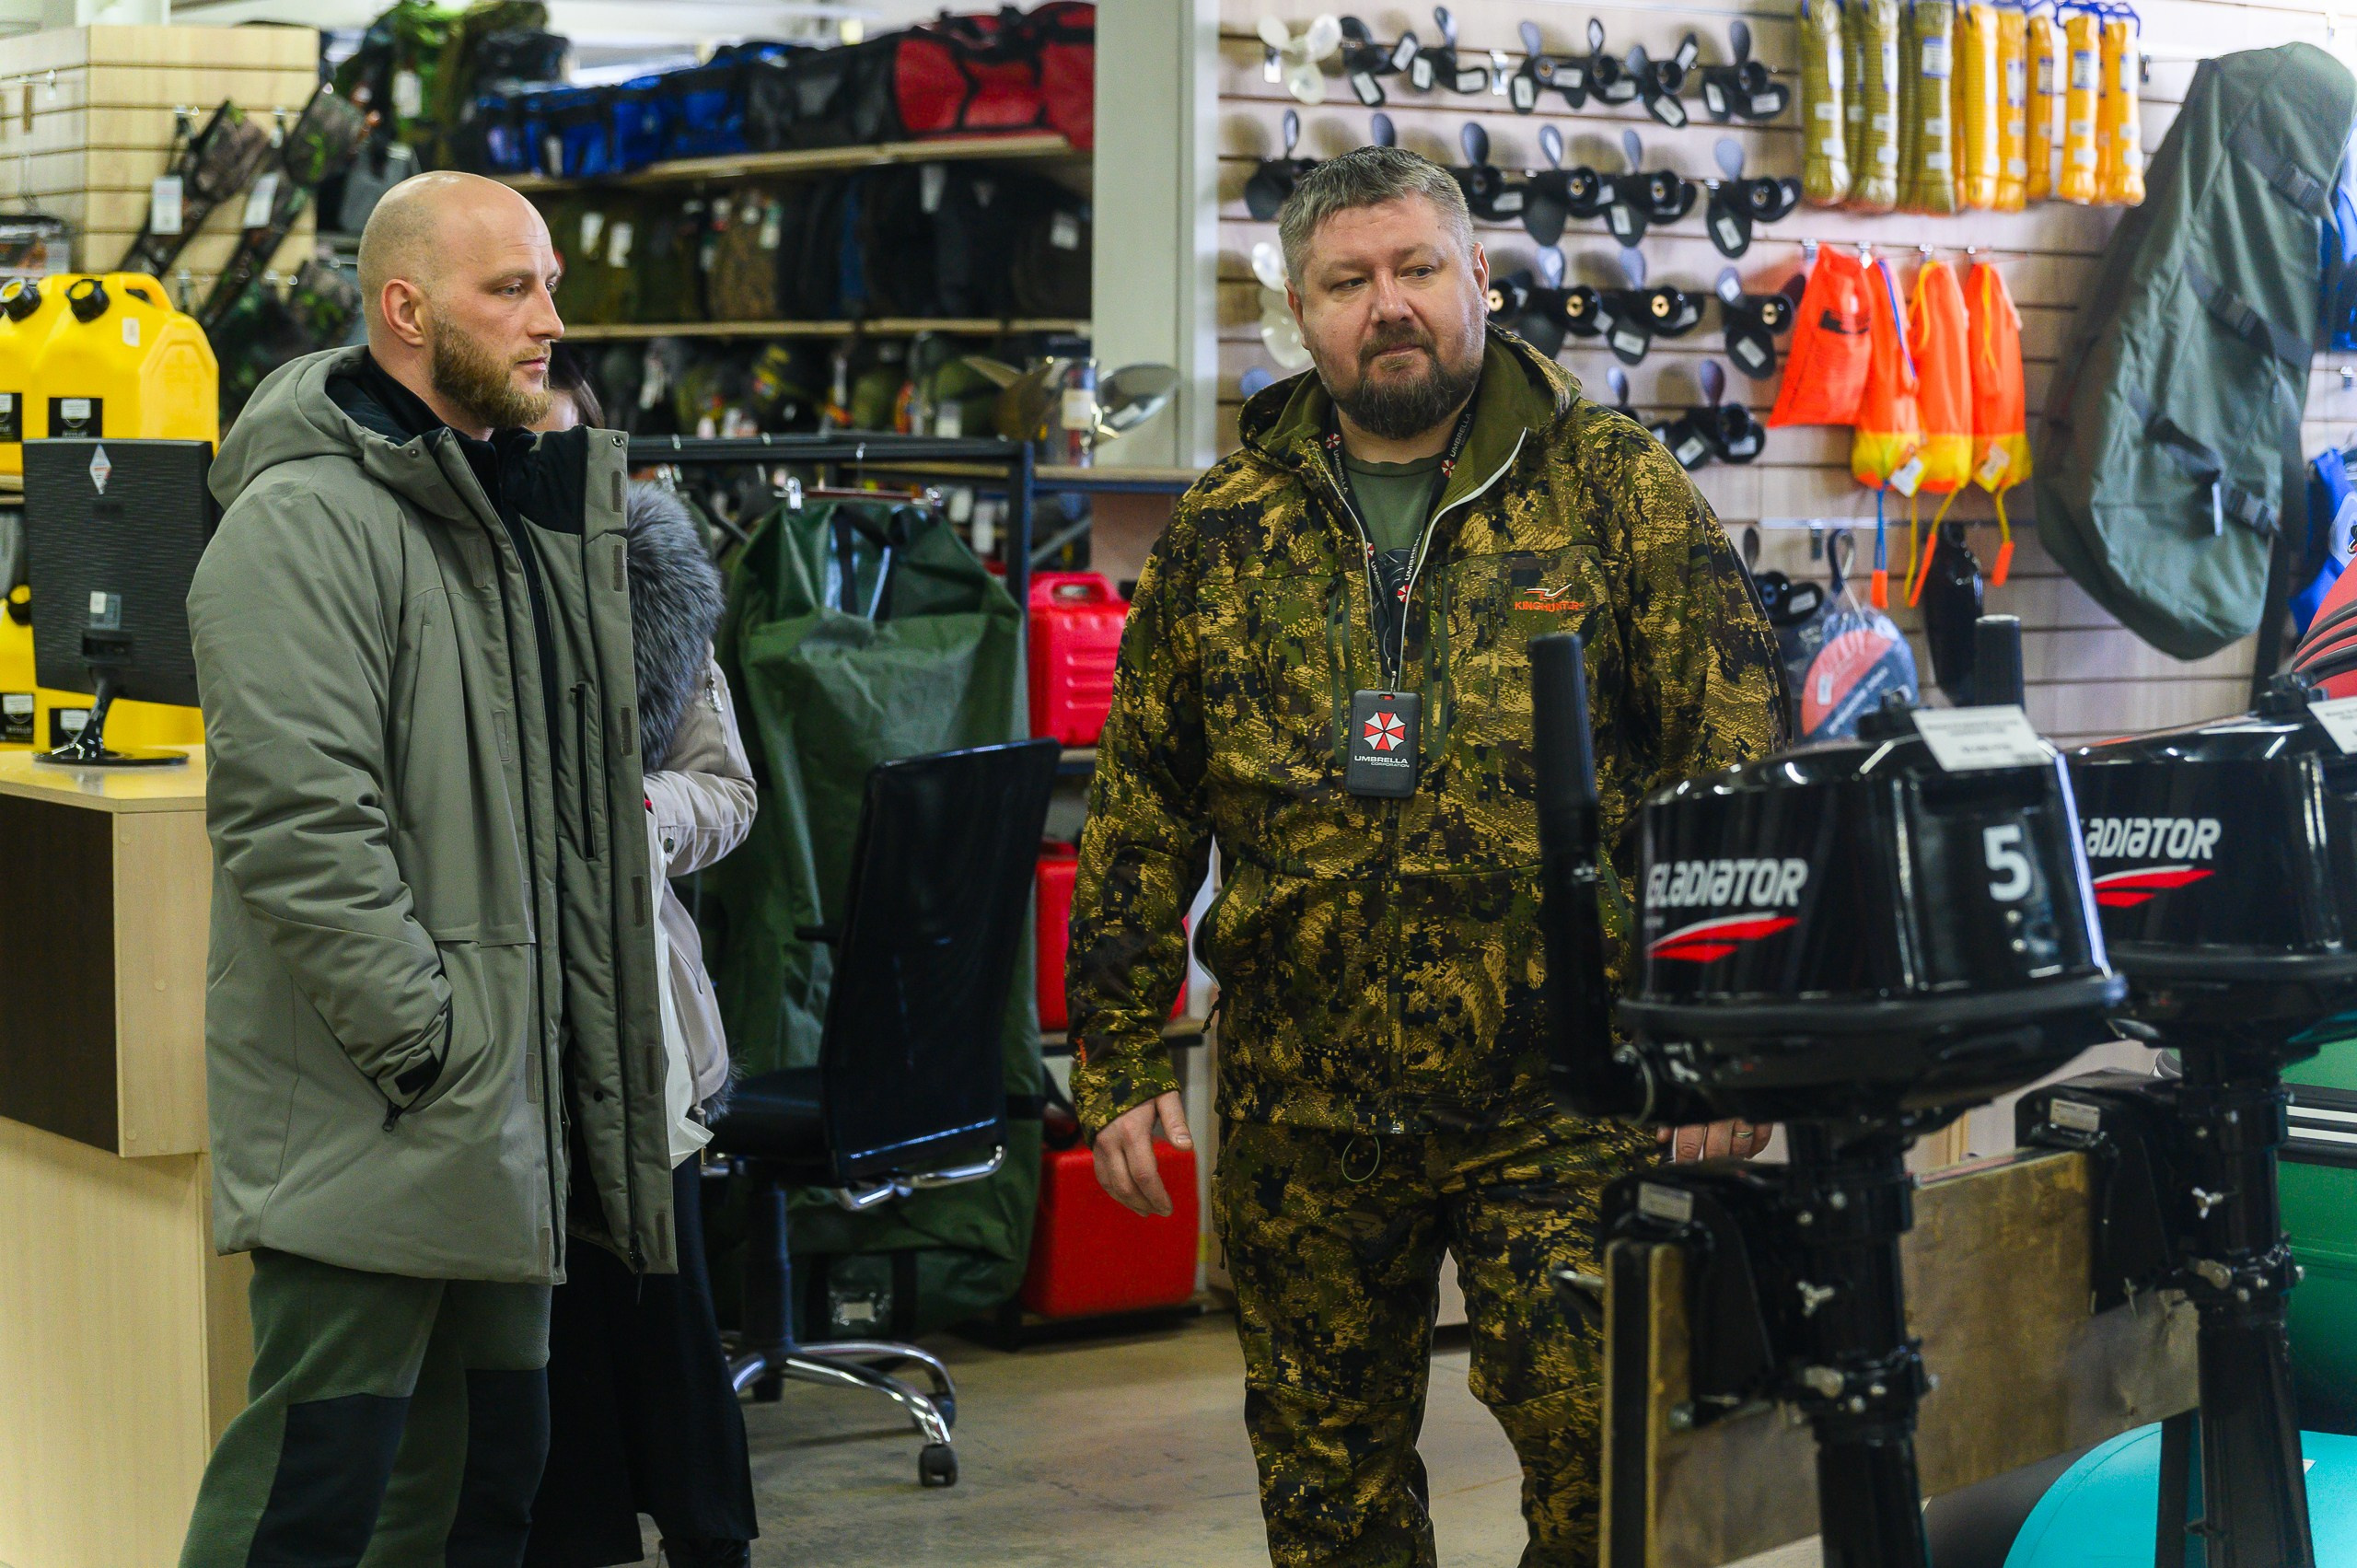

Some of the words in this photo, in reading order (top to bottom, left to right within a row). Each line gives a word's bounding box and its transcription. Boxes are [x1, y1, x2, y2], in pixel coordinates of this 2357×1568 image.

[1450, 413, 1471, 458] UMBRELLA
[1333, 449, 1349, 494] UMBRELLA
[1353, 755, 1409, 765] UMBRELLA
[1983, 823, 2033, 901] 5
